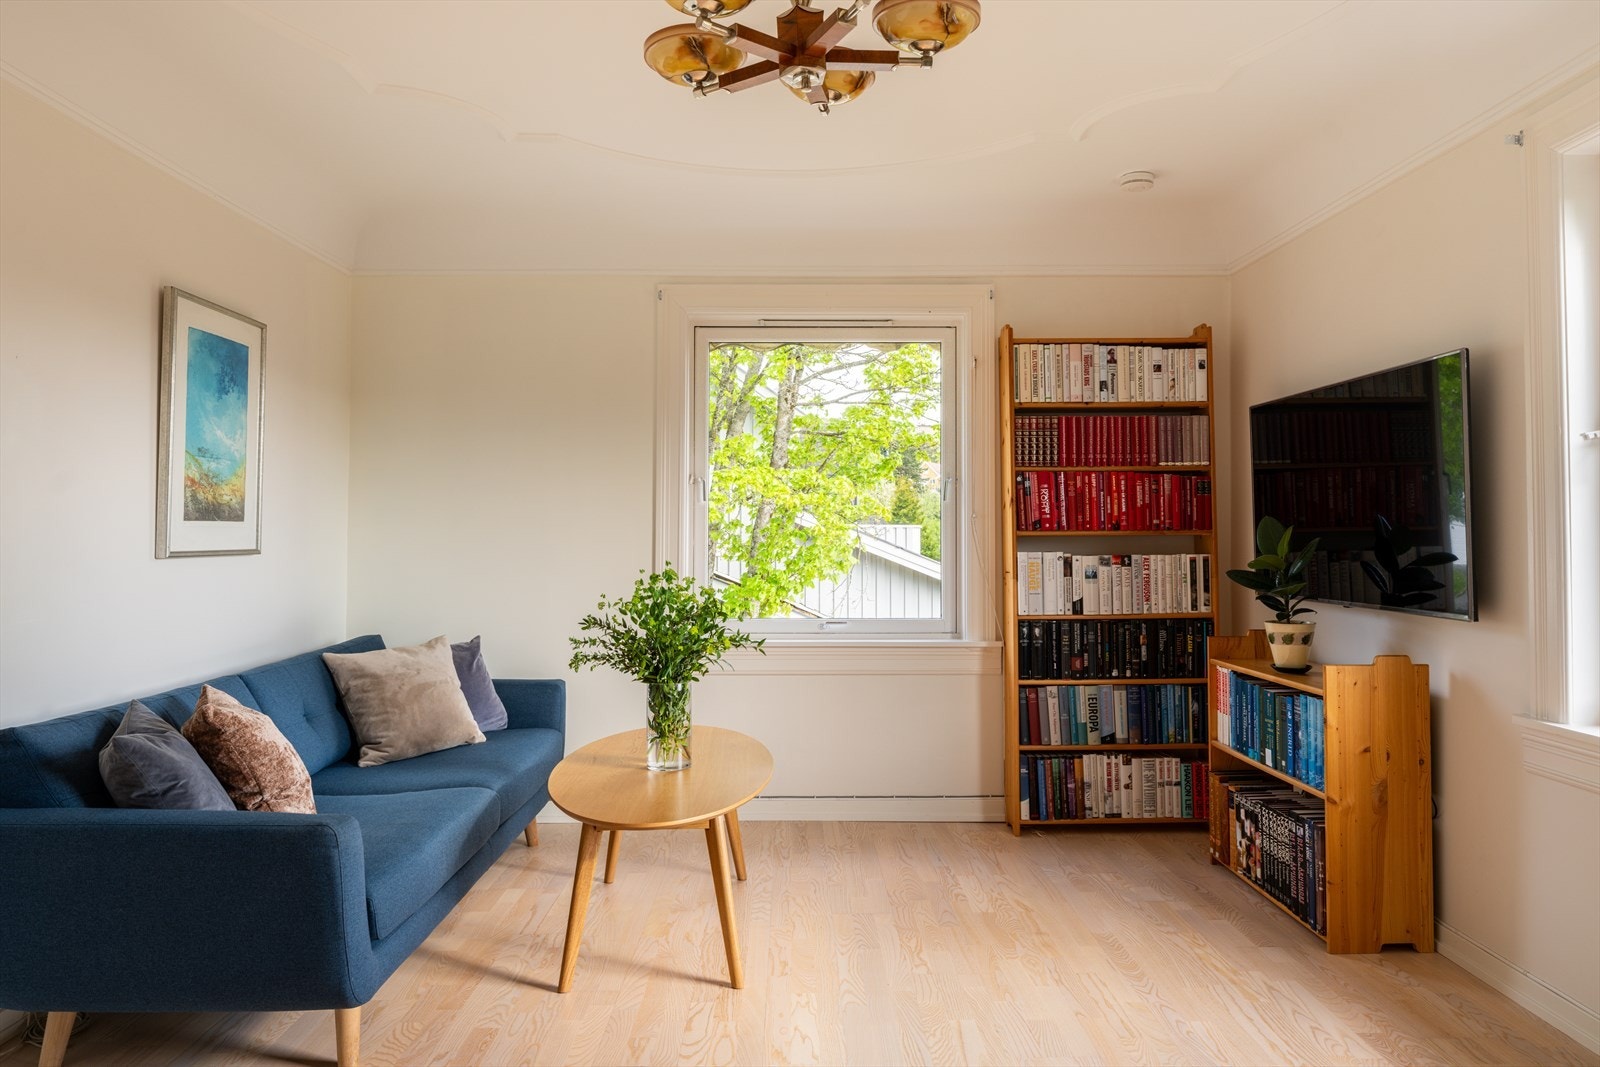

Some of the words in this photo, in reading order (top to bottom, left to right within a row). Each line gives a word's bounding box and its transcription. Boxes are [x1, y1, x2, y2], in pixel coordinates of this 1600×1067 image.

[1143, 573, 1151, 603] FERGUSON
[1088, 697, 1099, 733] EUROPA
[1144, 774, 1156, 809] SKYLDIGE
[1184, 765, 1192, 797] HAAKON
